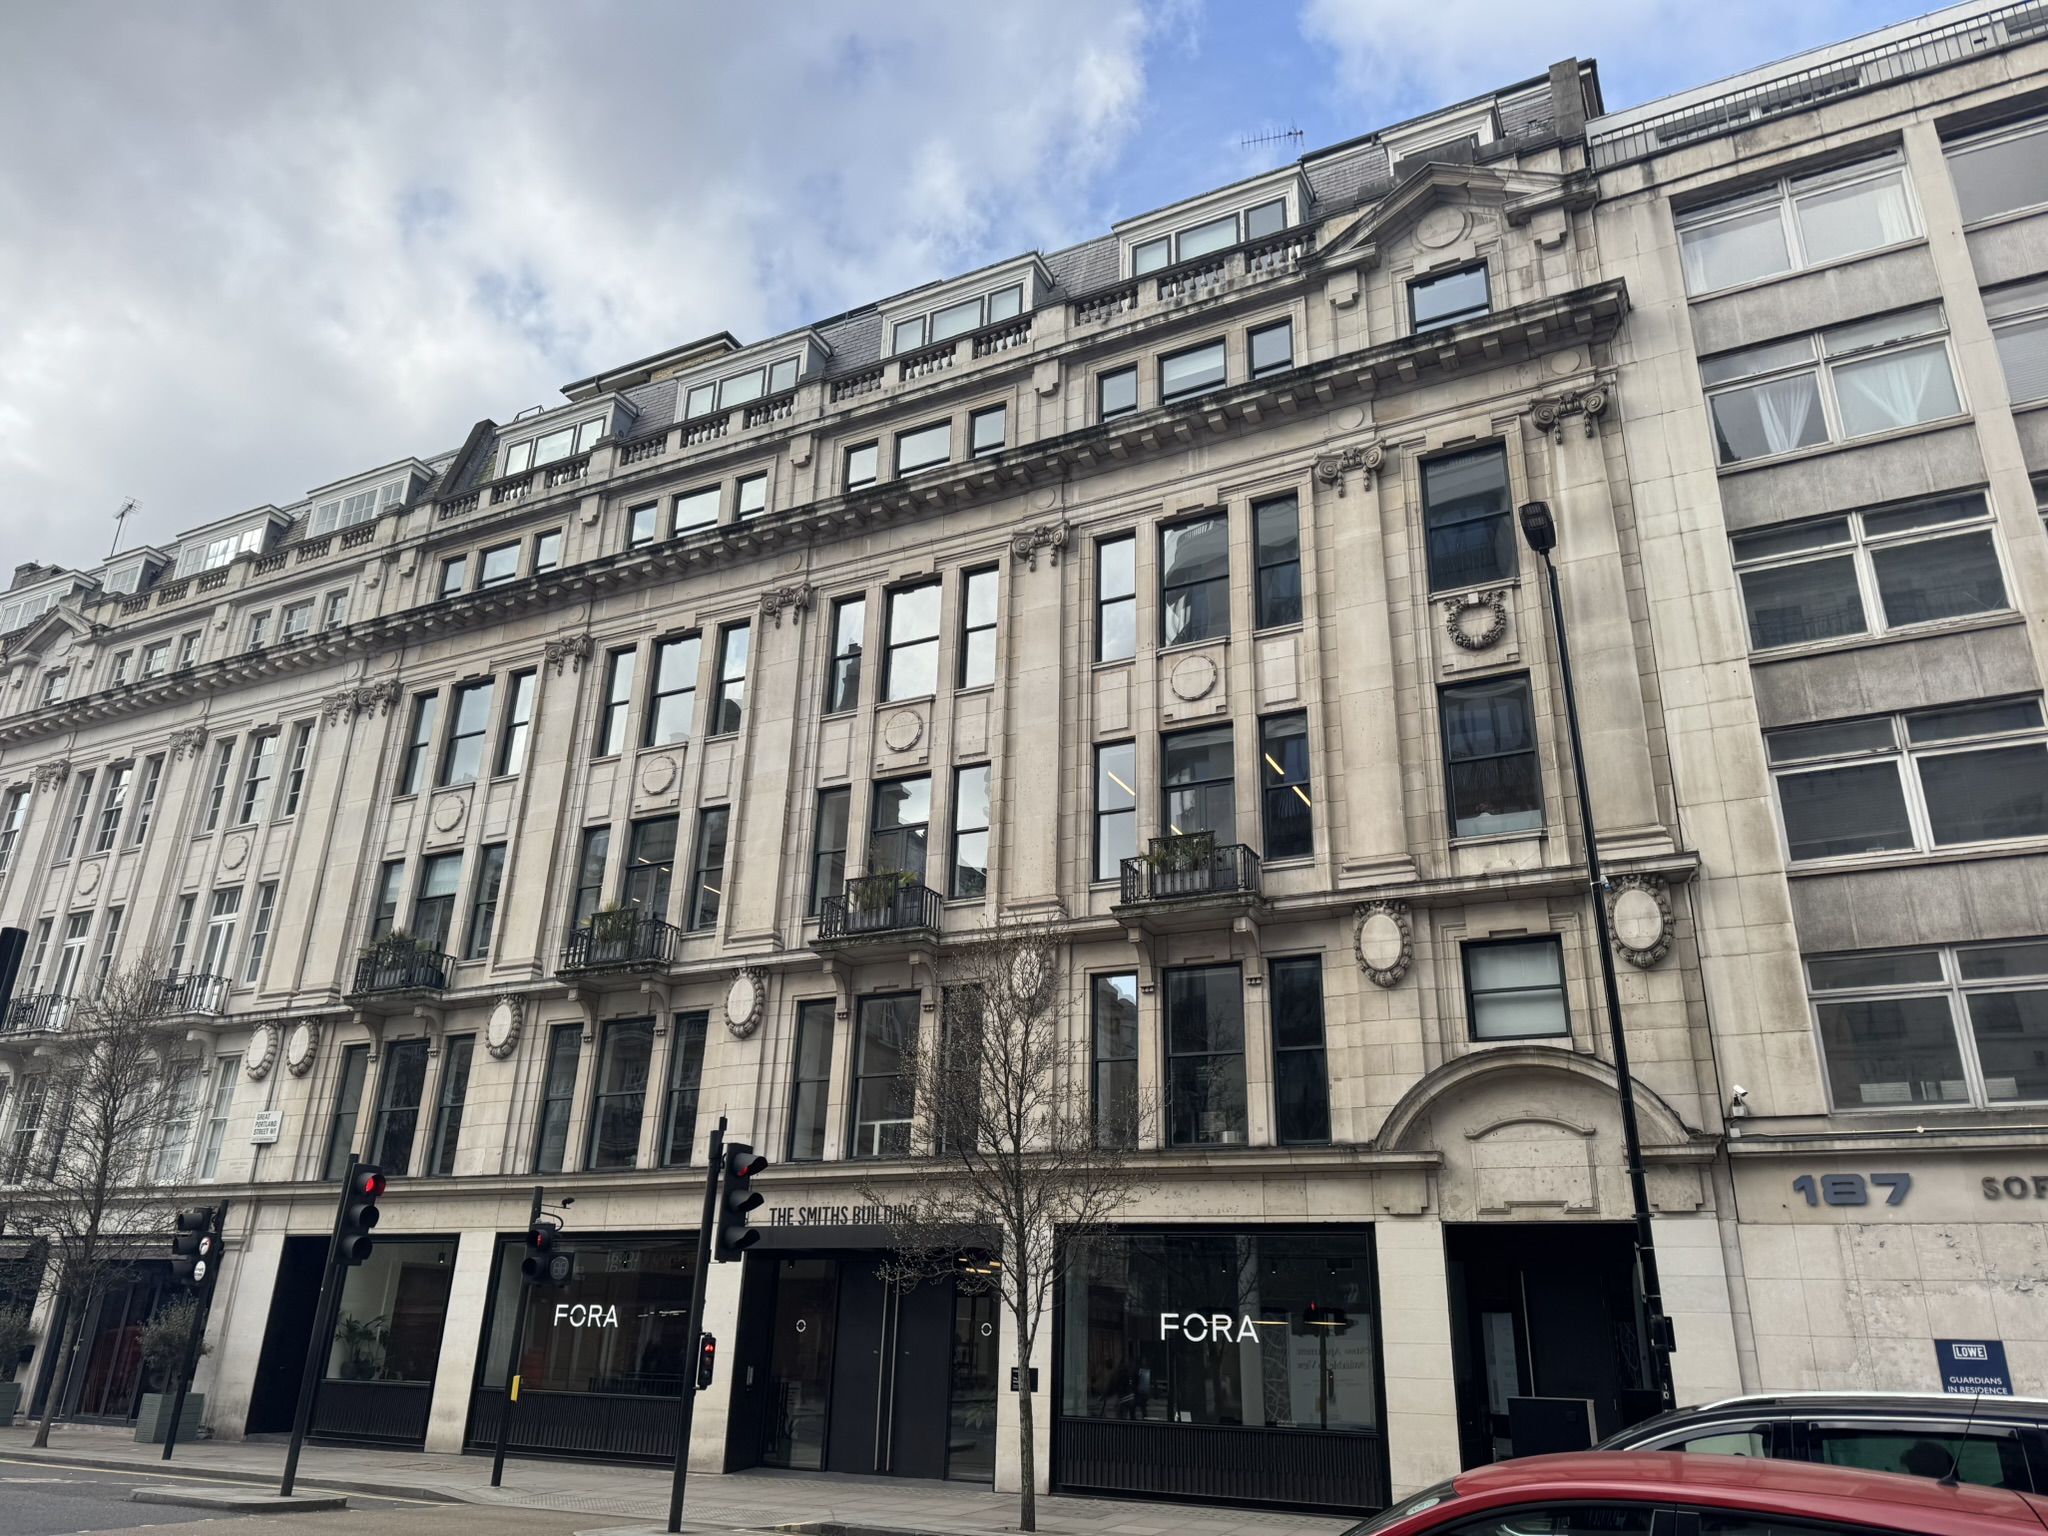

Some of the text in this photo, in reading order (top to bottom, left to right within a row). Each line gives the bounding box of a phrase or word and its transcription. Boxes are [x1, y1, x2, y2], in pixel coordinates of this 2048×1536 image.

[254, 1120, 277, 1128] PORTLAND
[253, 1128, 269, 1136] STREET
[1792, 1172, 1912, 1208] 187
[769, 1204, 917, 1226] THE SMITHS BUILDING
[553, 1304, 619, 1328] FORA
[1160, 1312, 1260, 1344] FORA
[1955, 1347, 1985, 1357] LOWE
[1949, 1376, 2003, 1385] GUARDIANS
[1960, 1386, 2008, 1395] RESIDENCE
